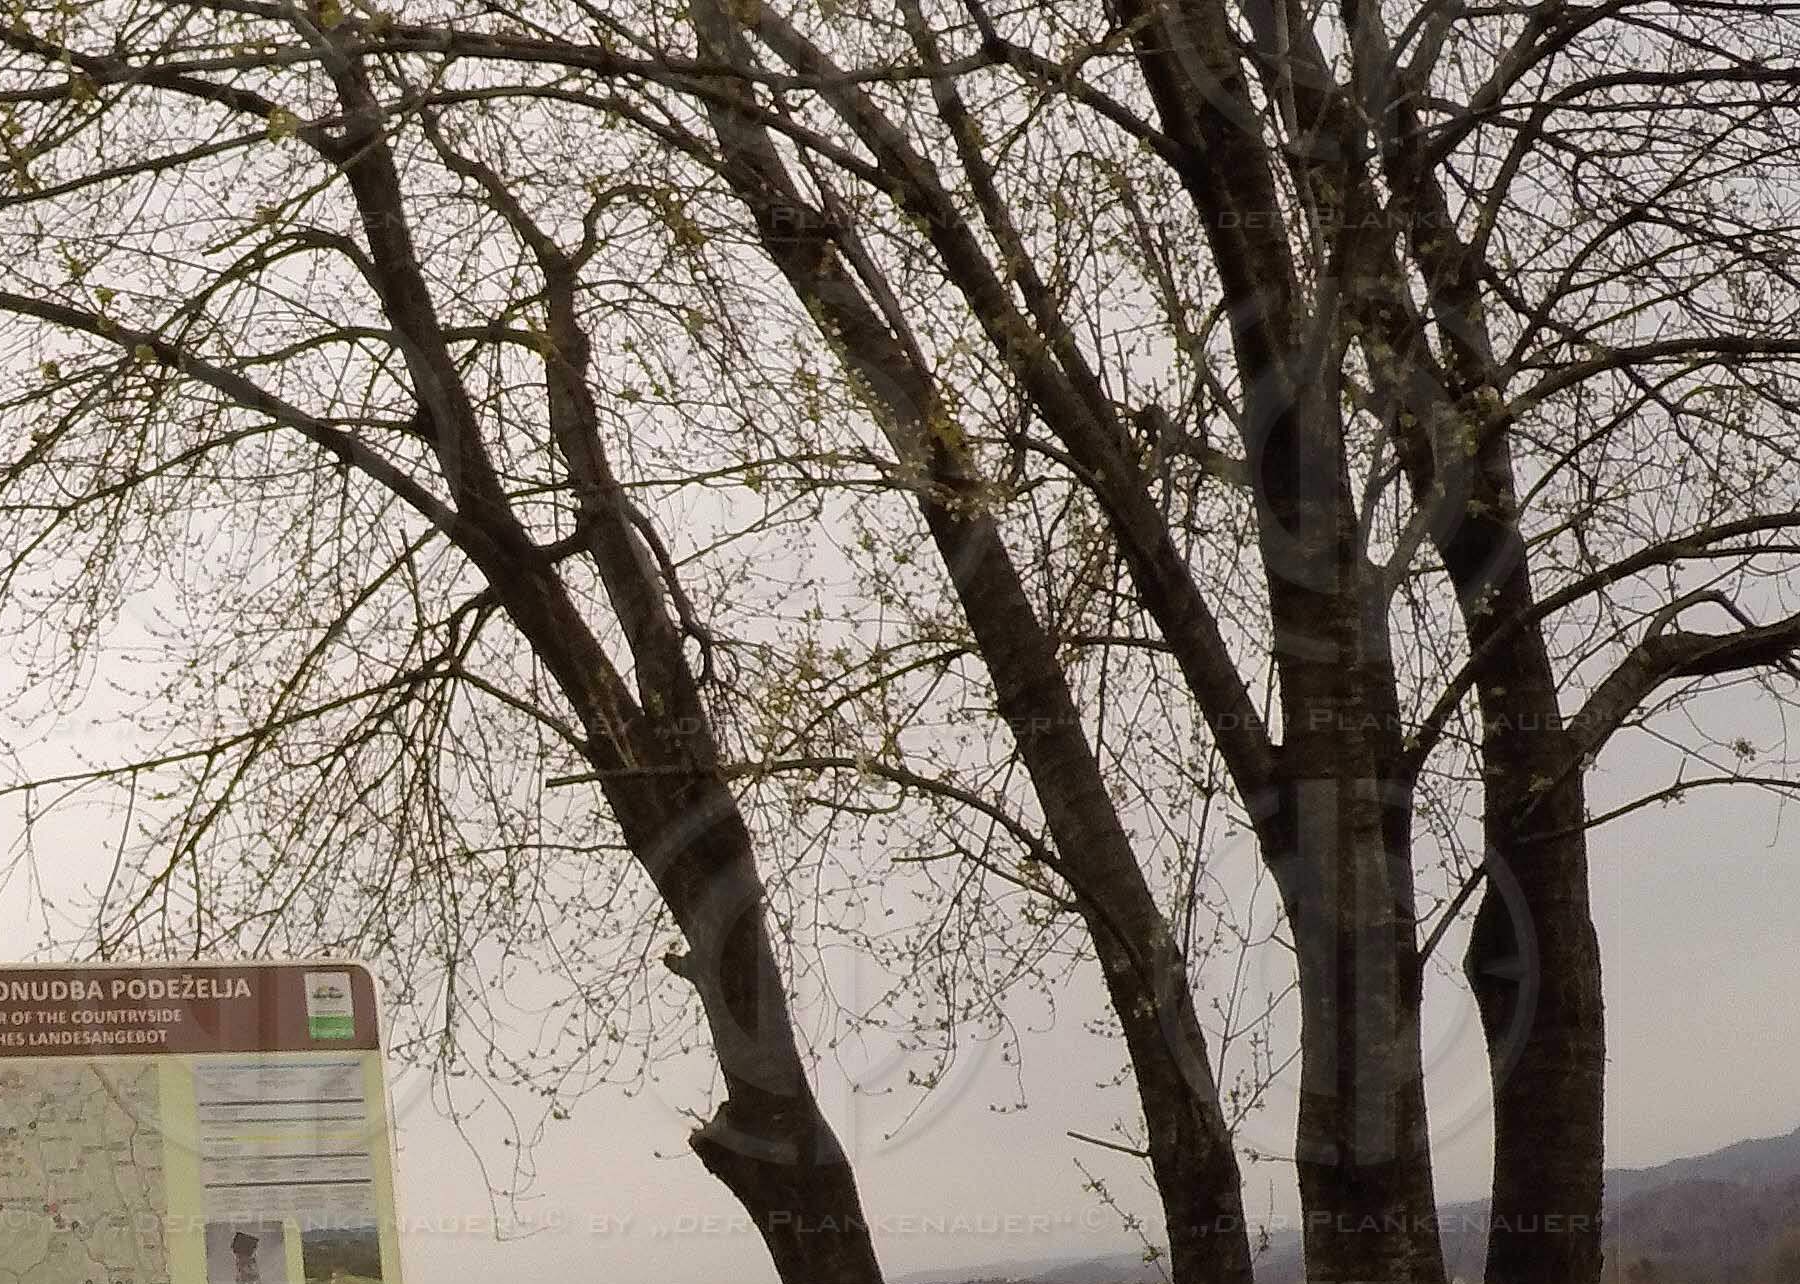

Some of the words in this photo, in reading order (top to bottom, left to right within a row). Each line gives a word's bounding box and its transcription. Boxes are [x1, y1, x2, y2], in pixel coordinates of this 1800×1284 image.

[111, 974, 252, 1001] PODEŽELJA
[11, 1010, 33, 1025] OF
[37, 1010, 67, 1025] THE
[71, 1008, 183, 1025] COUNTRYSIDE
[28, 1028, 169, 1047] LANDESANGEBOT
